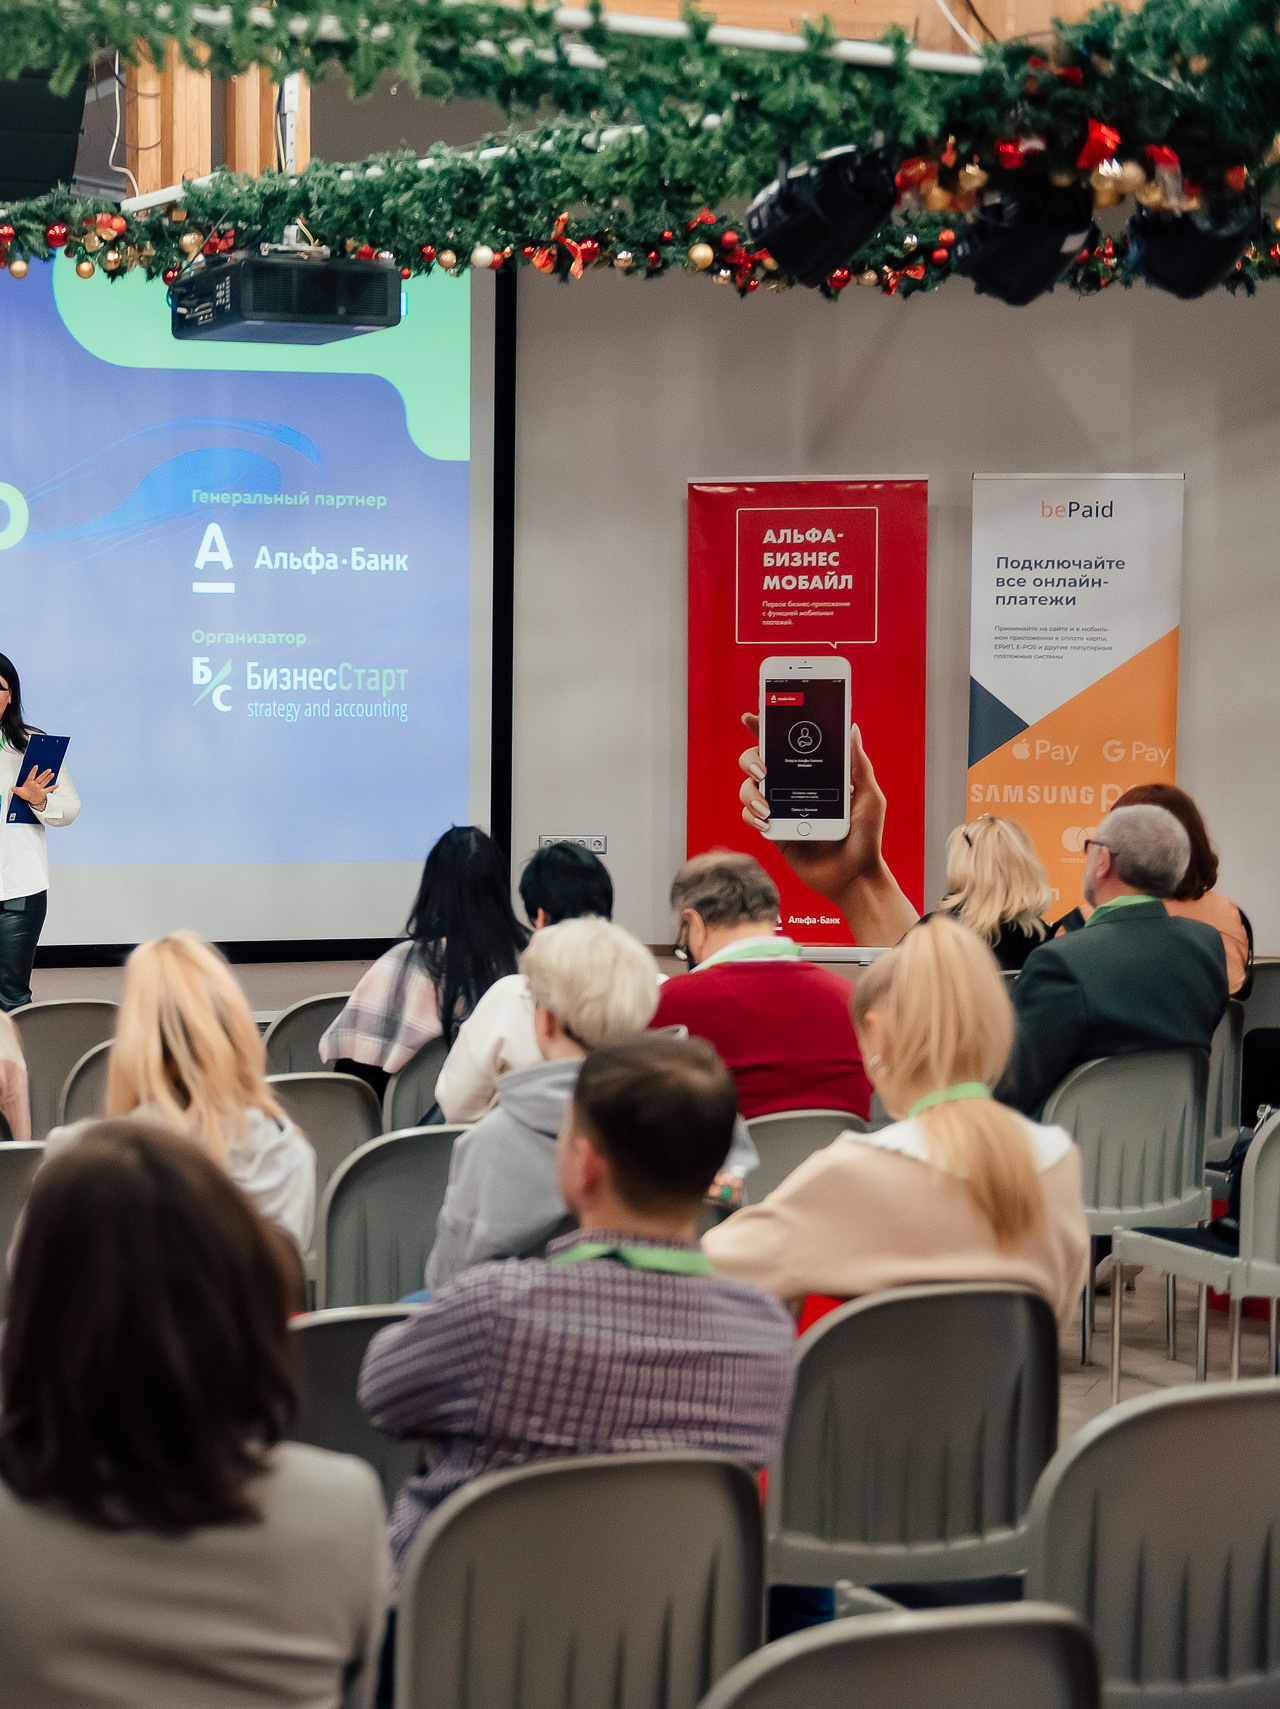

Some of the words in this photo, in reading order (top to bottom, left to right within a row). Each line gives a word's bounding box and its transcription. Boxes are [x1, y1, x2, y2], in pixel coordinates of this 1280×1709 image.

[192, 489, 310, 507] Генеральный
[315, 495, 388, 509] партнер
[1041, 500, 1113, 518] bePaid
[762, 527, 844, 544] АЛЬФА-
[763, 551, 840, 567] БИЗНЕС
[996, 556, 1126, 571] Подключайте
[762, 571, 853, 590] МОБАЙЛ
[995, 577, 1027, 588] все
[1032, 574, 1109, 588] онлайн-
[995, 595, 1077, 606] платежи
[192, 629, 307, 647] Организатор
[246, 661, 409, 698] БизнесСтарт
[247, 700, 301, 723] strategy
[304, 699, 330, 718] and
[334, 700, 409, 723] accounting
[1035, 739, 1079, 766] Pay
[1131, 741, 1171, 768] Pay
[970, 783, 1094, 805] SAMSUNG
